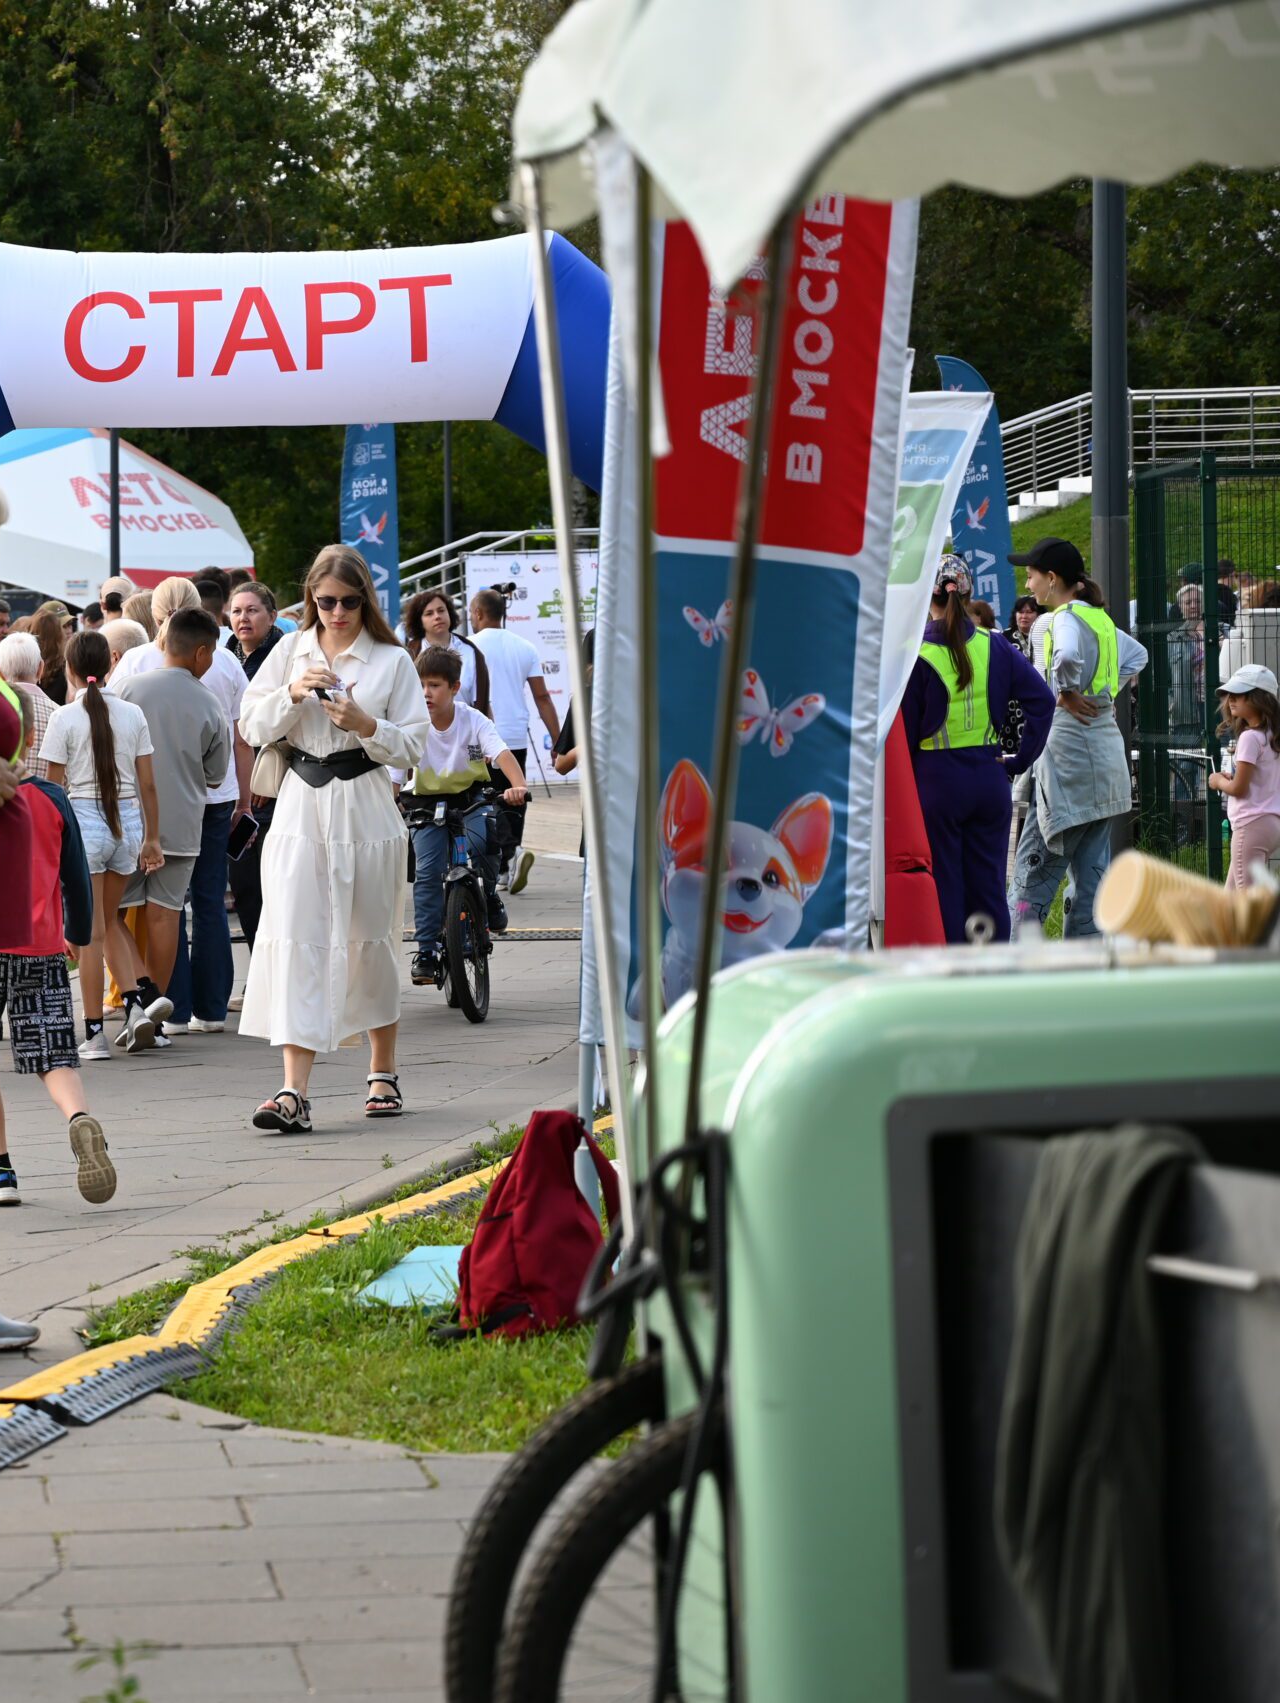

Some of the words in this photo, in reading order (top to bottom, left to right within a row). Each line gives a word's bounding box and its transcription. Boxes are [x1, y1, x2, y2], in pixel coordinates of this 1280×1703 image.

[64, 273, 452, 383] СТАРТ
[790, 192, 846, 421] МОСКВ
[785, 442, 823, 484] В
